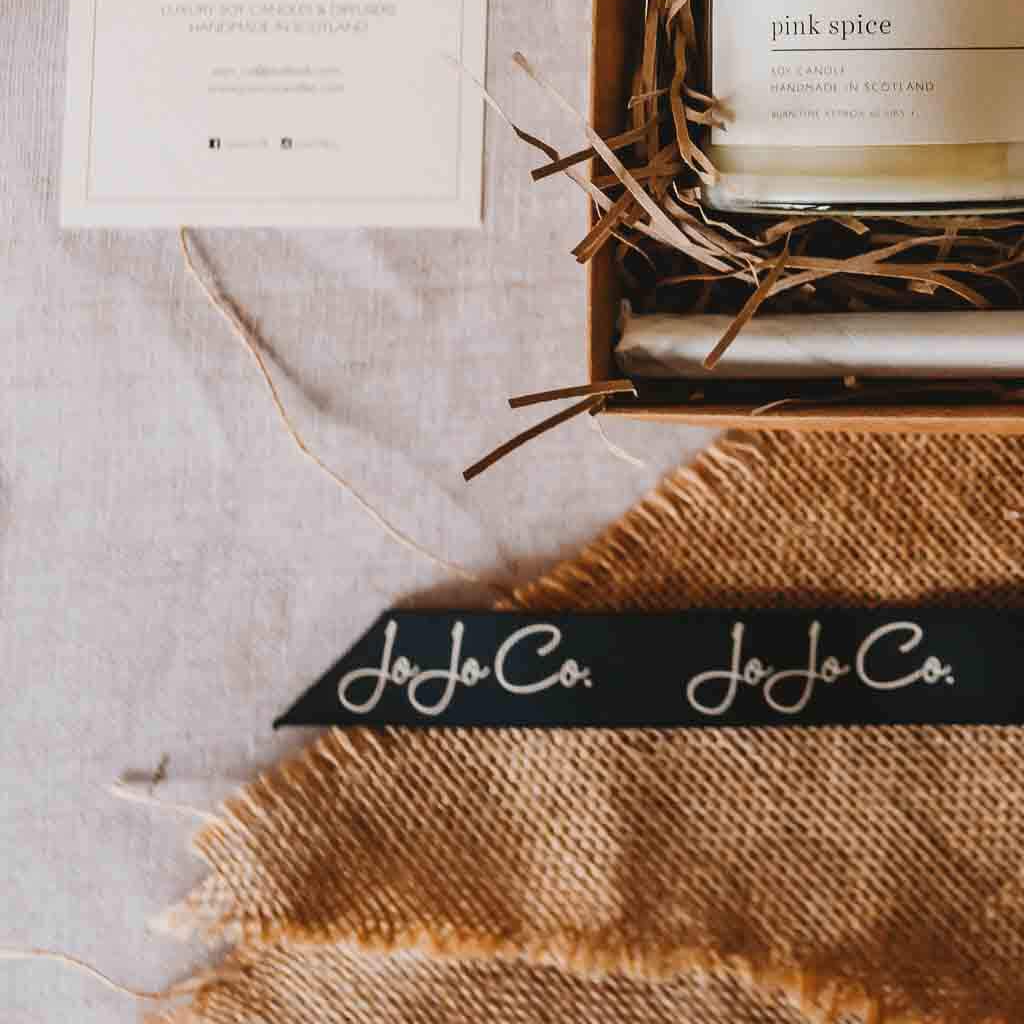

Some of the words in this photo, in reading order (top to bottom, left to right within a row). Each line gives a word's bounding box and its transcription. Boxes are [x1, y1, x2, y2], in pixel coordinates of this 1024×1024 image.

[771, 13, 821, 41] pink
[829, 13, 892, 41] spice
[771, 83, 838, 94] HANDMADE
[863, 81, 935, 94] SCOTLAND
[493, 622, 593, 694] Co.
[855, 621, 956, 690] Co.
